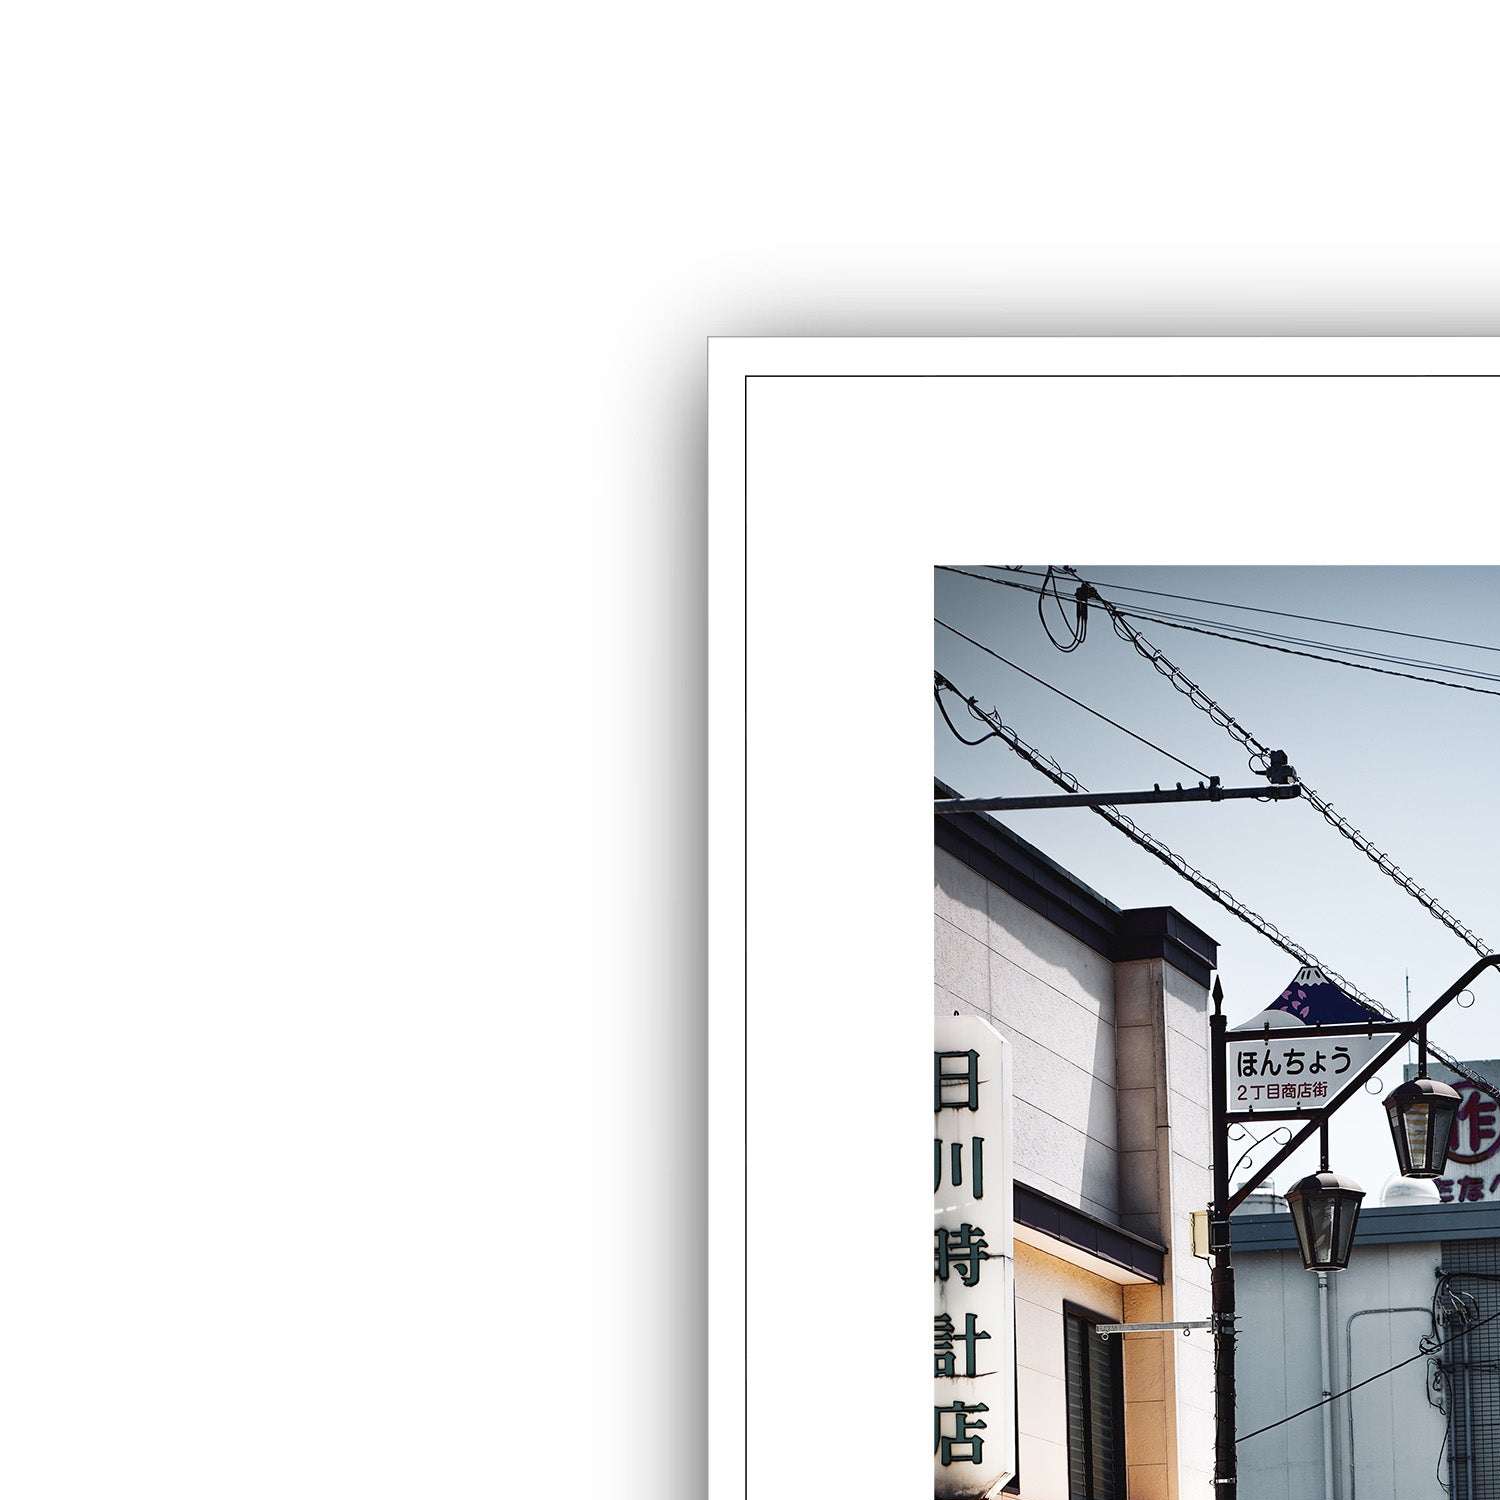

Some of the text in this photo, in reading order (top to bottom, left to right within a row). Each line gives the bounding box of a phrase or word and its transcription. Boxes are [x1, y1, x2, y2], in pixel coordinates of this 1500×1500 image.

[1237, 1046, 1351, 1077] ほんちょう
[1237, 1081, 1328, 1100] 2丁目商店街
[934, 1049, 990, 1466] 日川時計店
